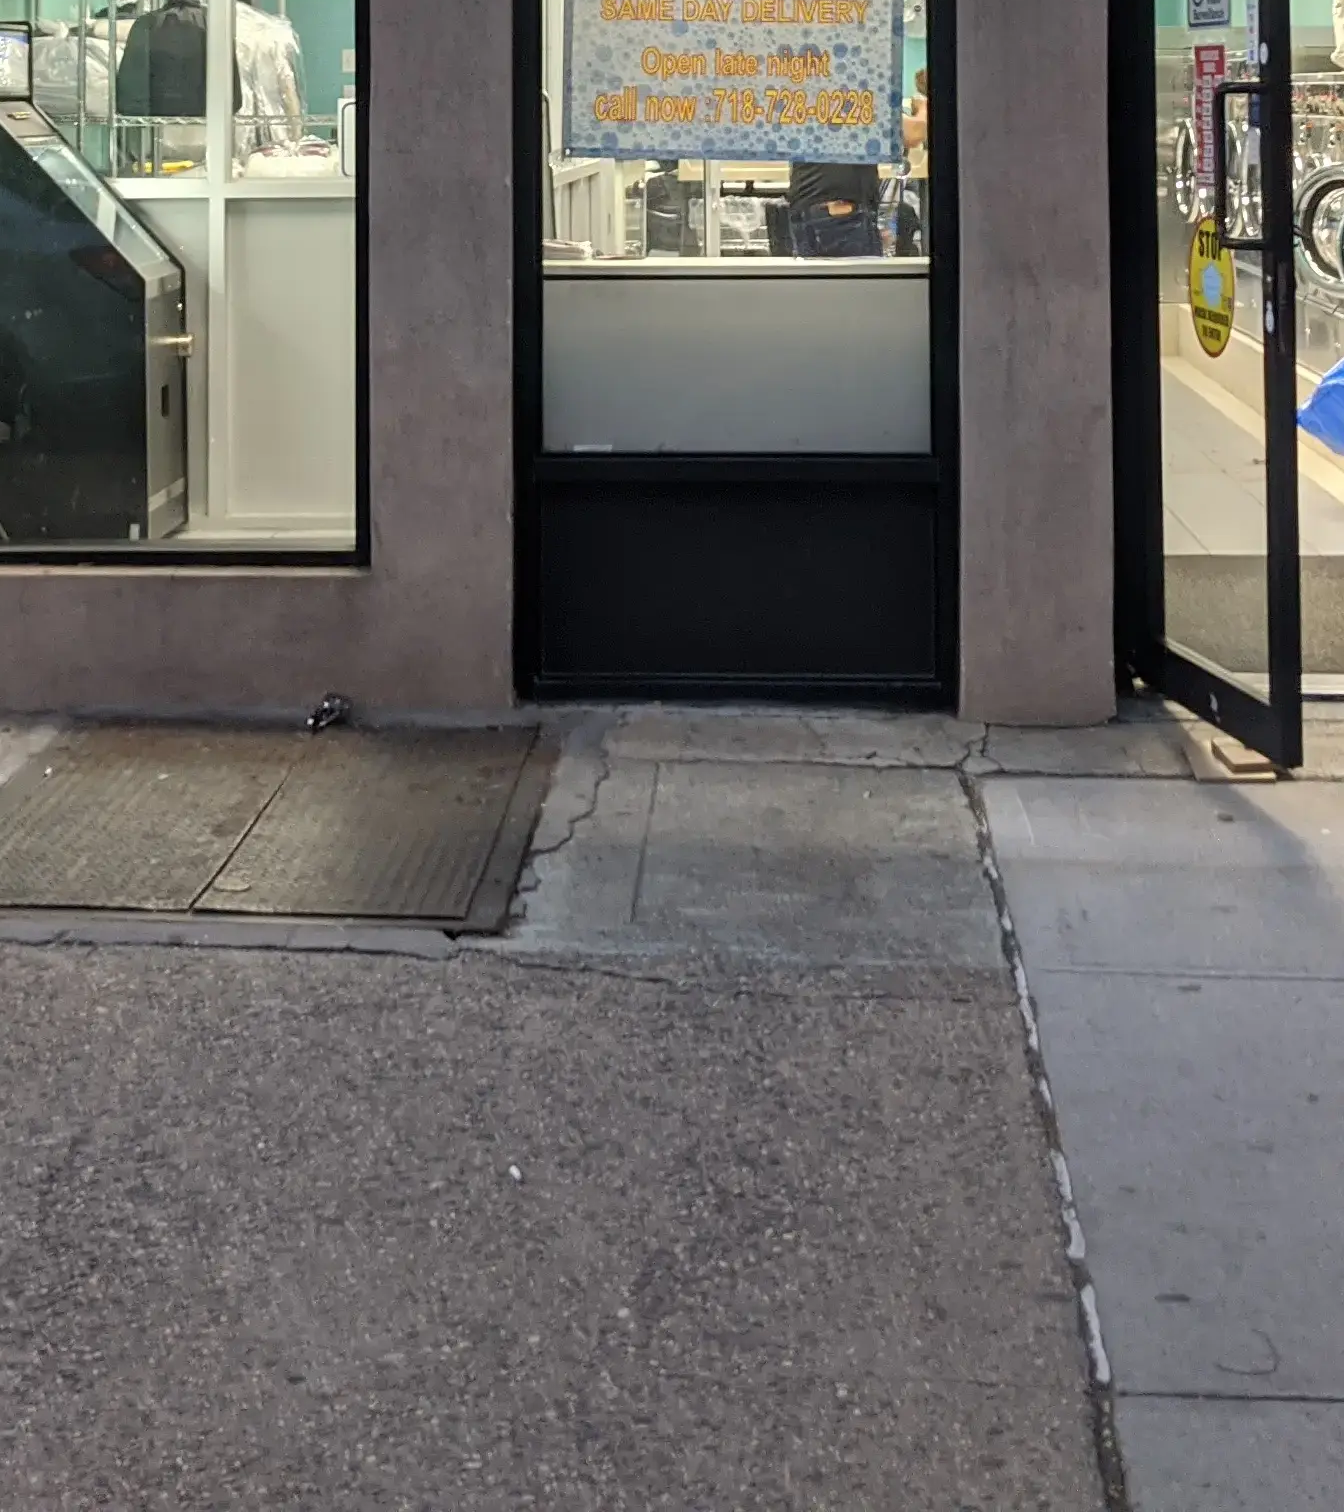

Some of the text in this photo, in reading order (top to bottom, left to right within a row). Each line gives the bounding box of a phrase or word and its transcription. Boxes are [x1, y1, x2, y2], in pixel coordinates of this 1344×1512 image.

[640, 45, 832, 83] Open late night
[593, 85, 639, 122] call
[644, 94, 698, 122] now
